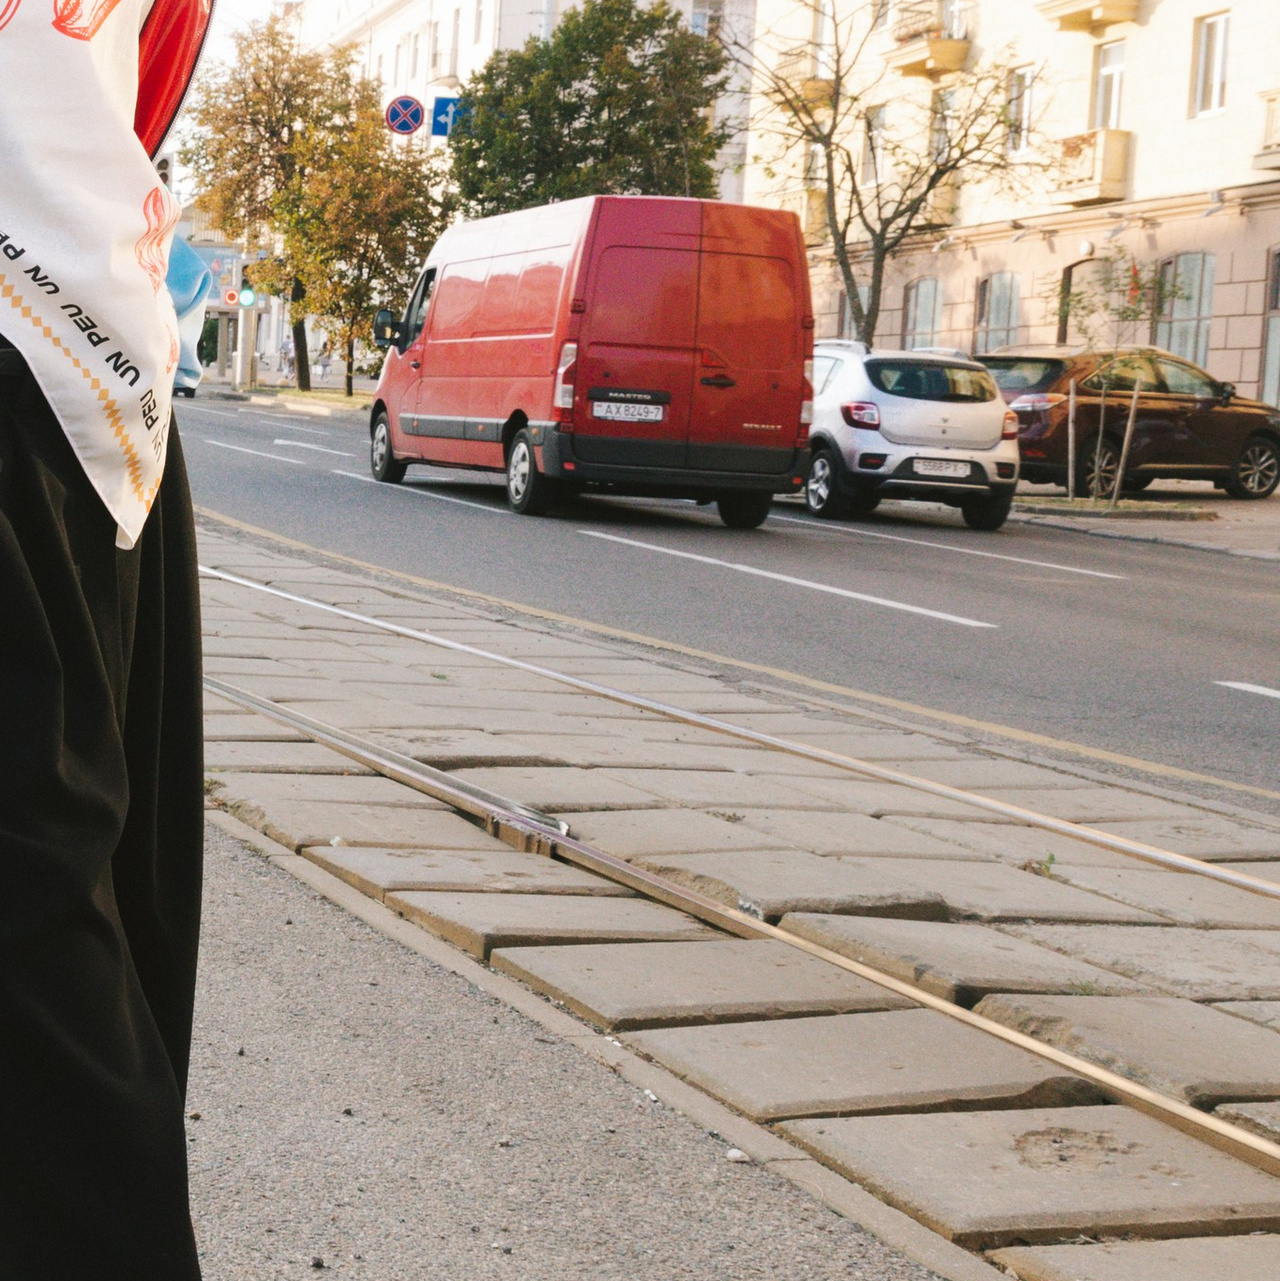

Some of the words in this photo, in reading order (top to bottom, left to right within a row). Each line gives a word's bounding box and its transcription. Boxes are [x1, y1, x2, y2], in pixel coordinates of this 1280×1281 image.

[23, 264, 60, 295] UN
[60, 303, 111, 348] PEU
[104, 350, 141, 387] UN
[139, 388, 159, 431] PEU
